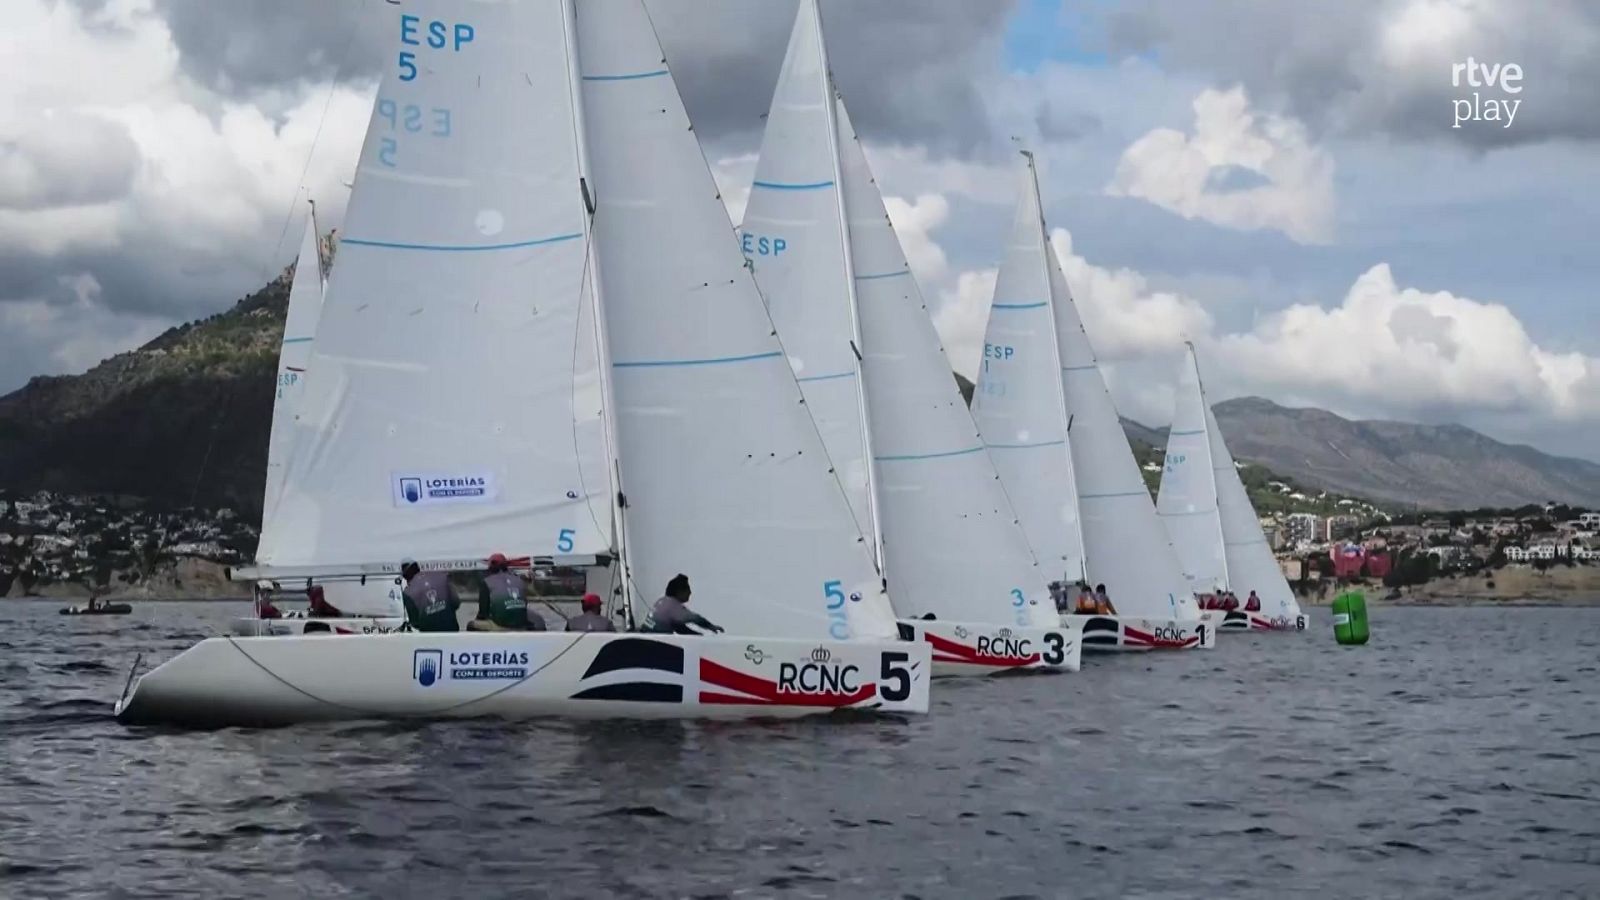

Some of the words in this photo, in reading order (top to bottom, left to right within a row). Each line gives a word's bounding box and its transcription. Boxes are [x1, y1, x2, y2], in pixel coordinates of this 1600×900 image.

[401, 15, 474, 51] ESP
[399, 51, 417, 81] 5
[742, 233, 786, 256] ESP
[984, 344, 1013, 360] ESP
[557, 528, 576, 552] 5
[823, 580, 846, 610] 5
[1010, 588, 1025, 607] 3
[1296, 615, 1305, 631] 6
[1154, 626, 1187, 641] RCNC
[1194, 624, 1206, 646] 1
[450, 650, 529, 666] LOTERÍAS
[977, 635, 1032, 658] RCNC
[1042, 632, 1065, 665] 3
[778, 662, 860, 693] RCNC
[880, 651, 911, 702] 5
